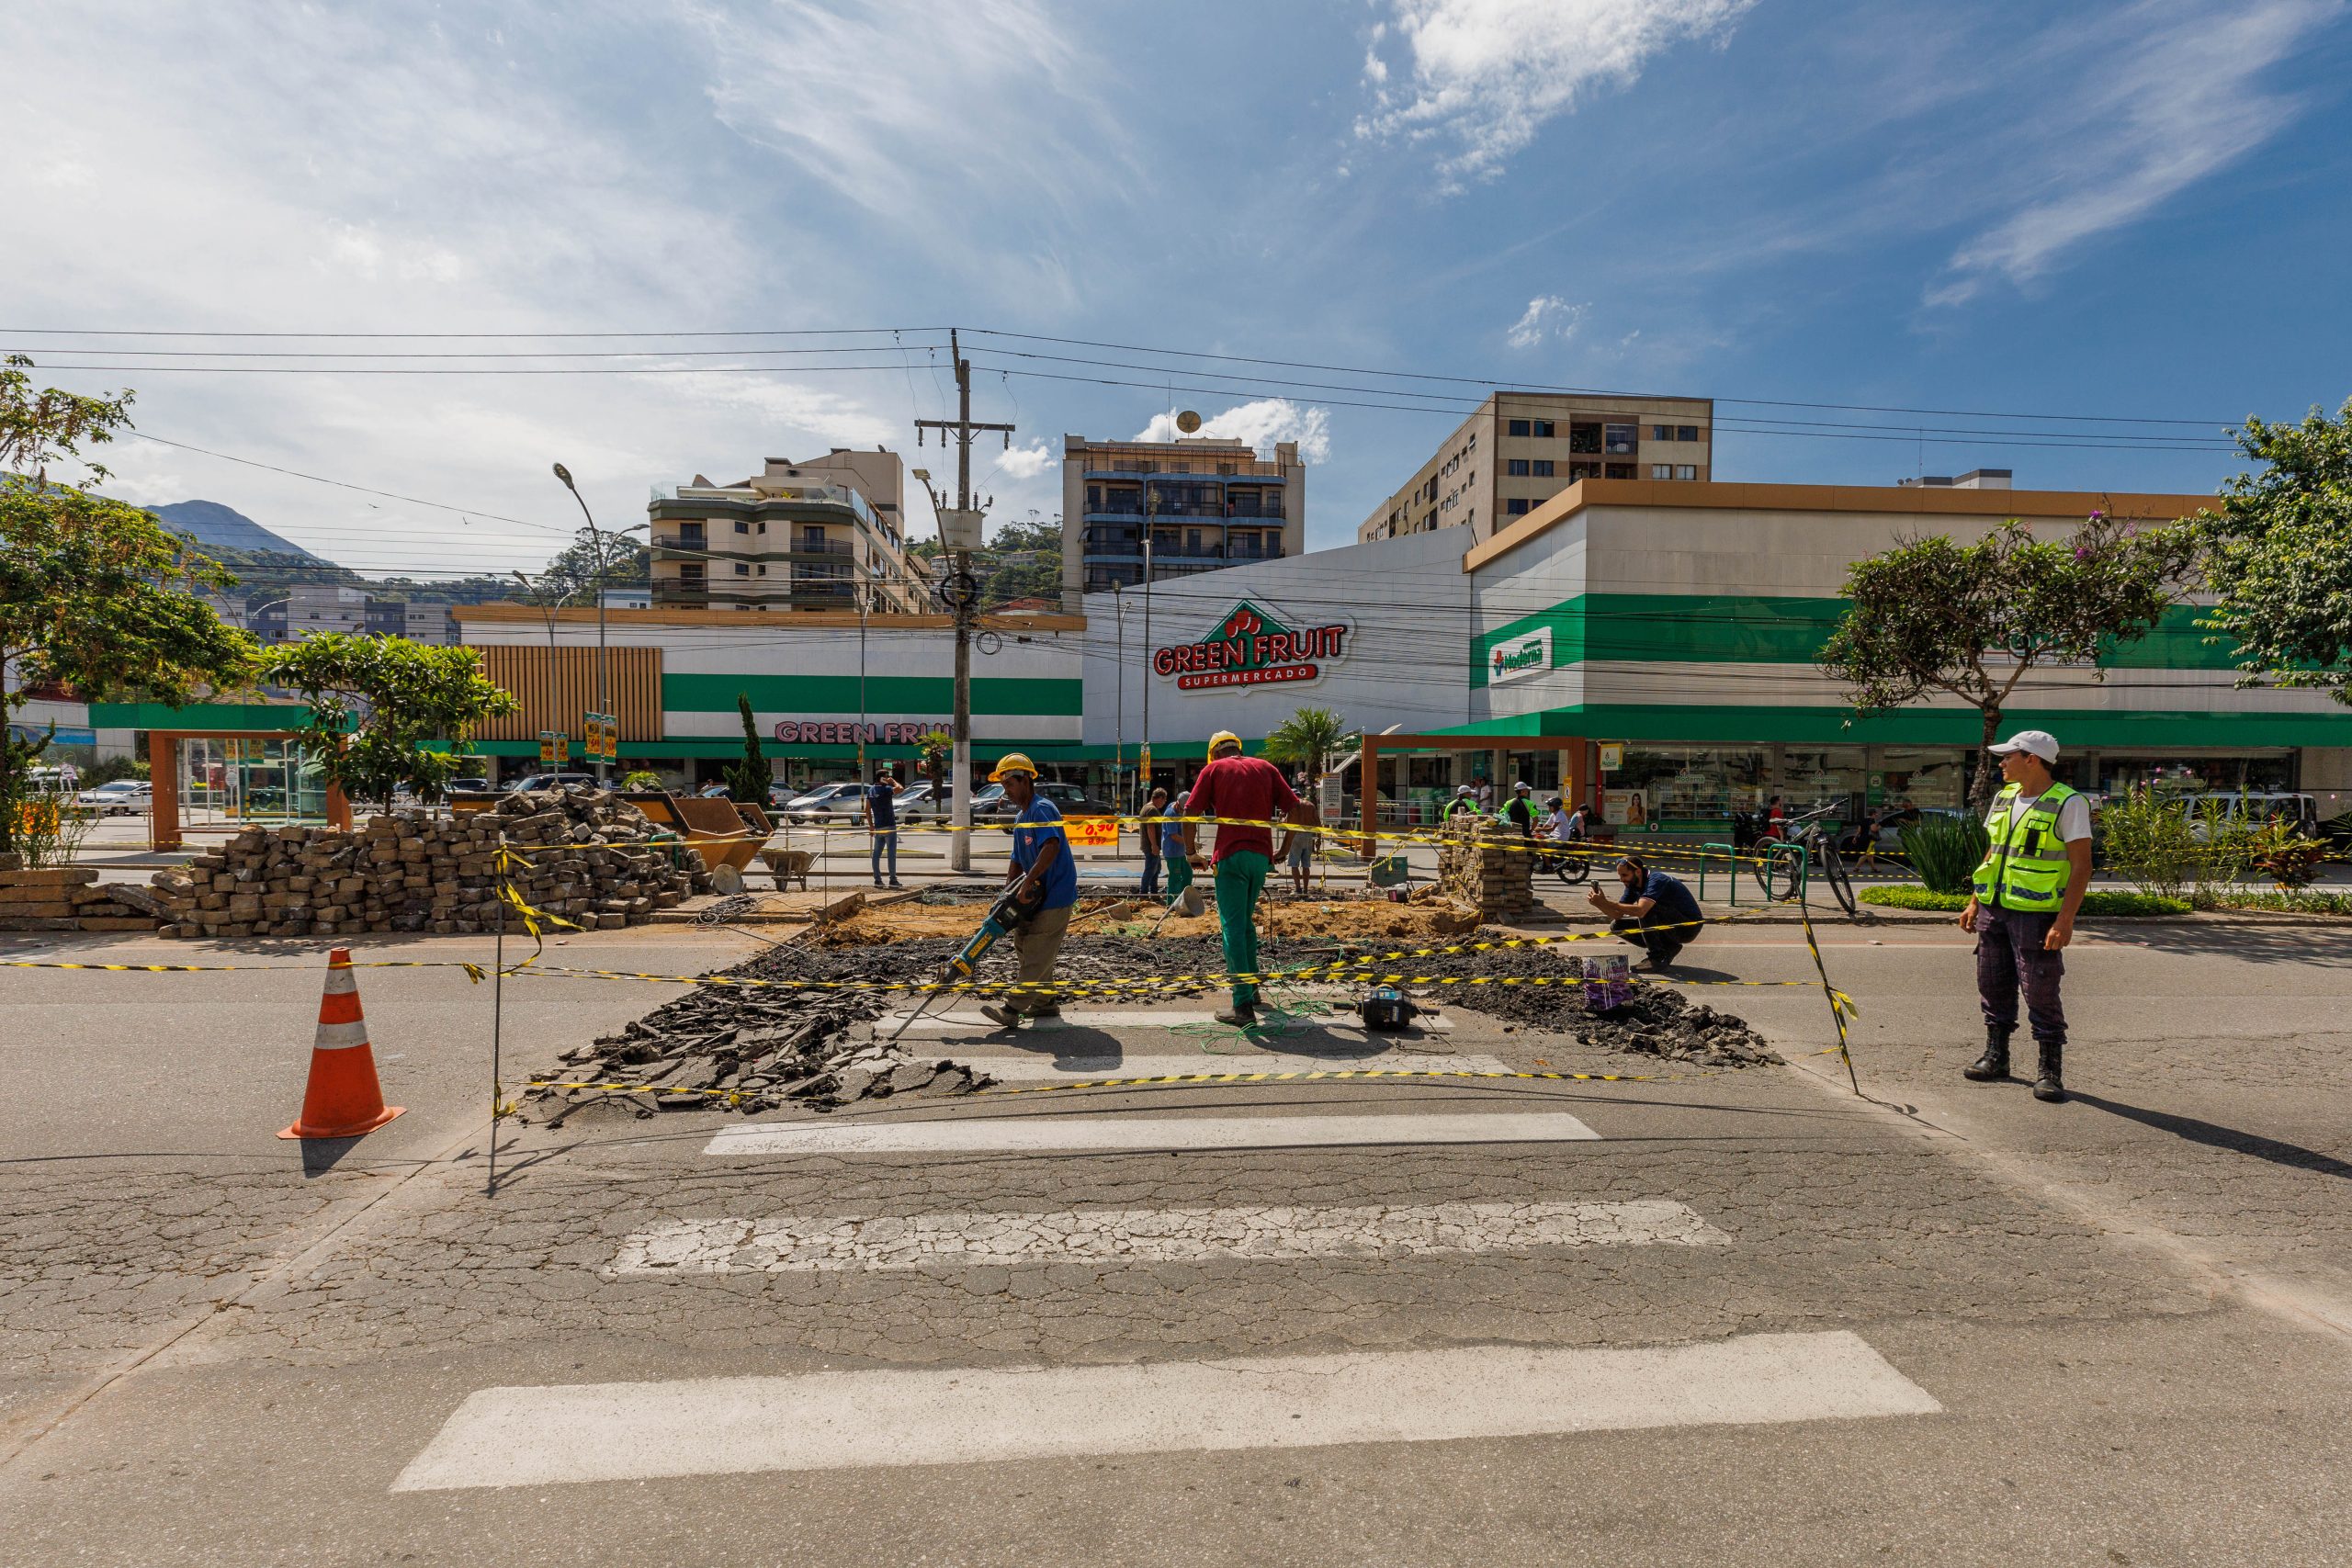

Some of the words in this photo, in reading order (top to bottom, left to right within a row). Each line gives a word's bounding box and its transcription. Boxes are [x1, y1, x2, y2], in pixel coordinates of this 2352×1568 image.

[1153, 637, 1245, 676] GREEN
[1252, 624, 1348, 664] FRUIT
[1504, 647, 1544, 671] Moderna
[1184, 667, 1307, 687] SUPERMERCADO
[775, 721, 876, 744] GREEN
